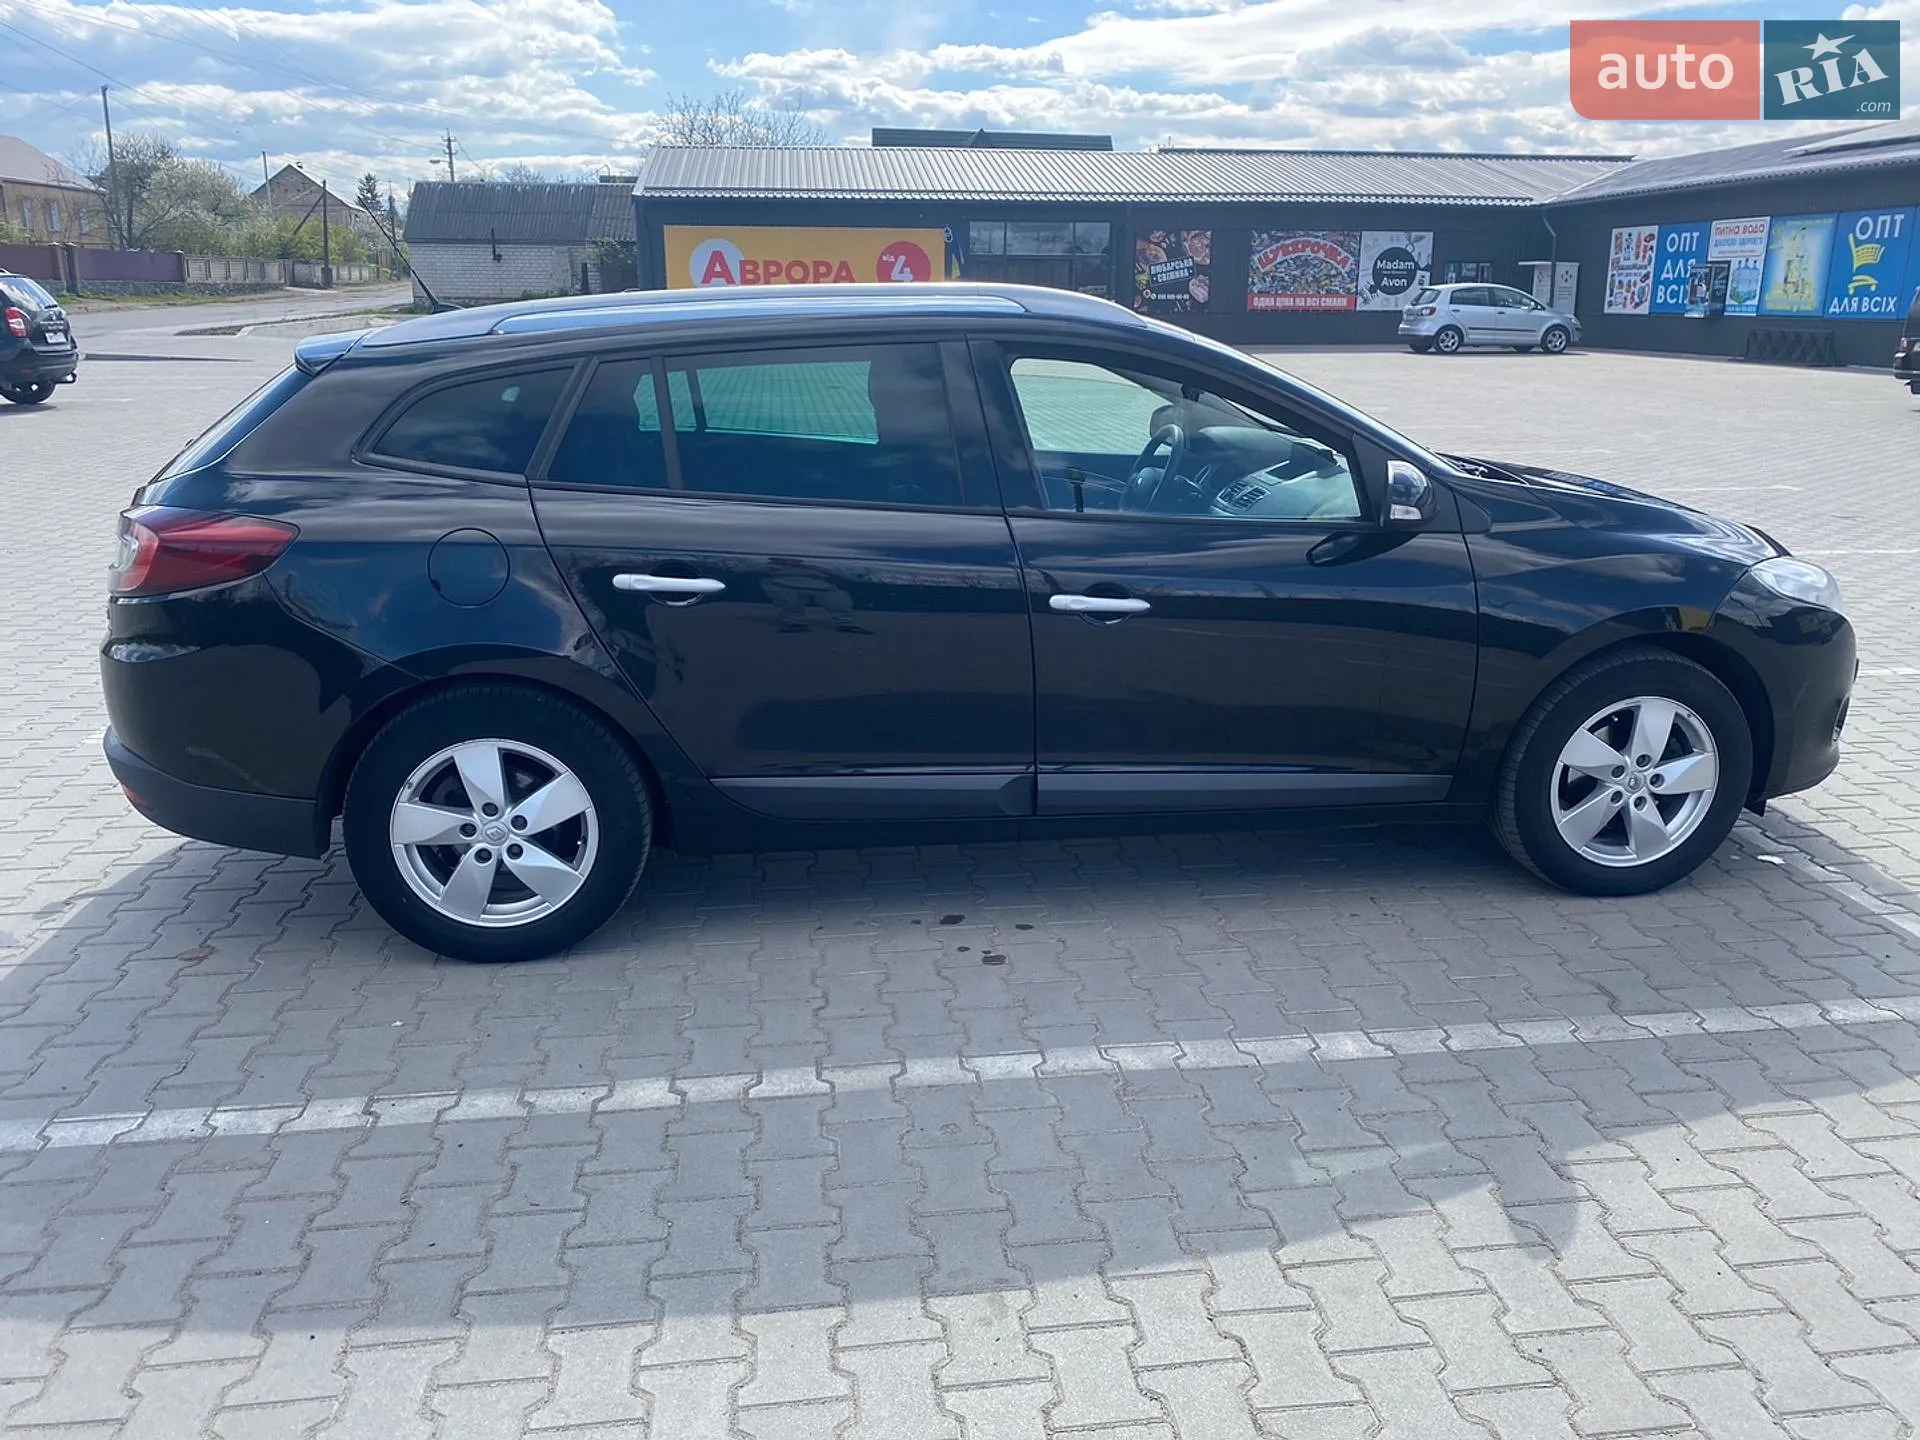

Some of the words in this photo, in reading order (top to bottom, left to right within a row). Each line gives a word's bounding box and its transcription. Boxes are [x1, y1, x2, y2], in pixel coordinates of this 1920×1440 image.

[1856, 213, 1905, 240] ОПТ
[1666, 232, 1700, 252] ОПТ
[891, 255, 913, 282] 4
[1377, 259, 1415, 270] Madam
[1380, 276, 1408, 287] Avon
[1656, 284, 1689, 304] ВСІ
[1828, 296, 1858, 315] ДЛЯ
[1861, 295, 1898, 313] ВСІХ
